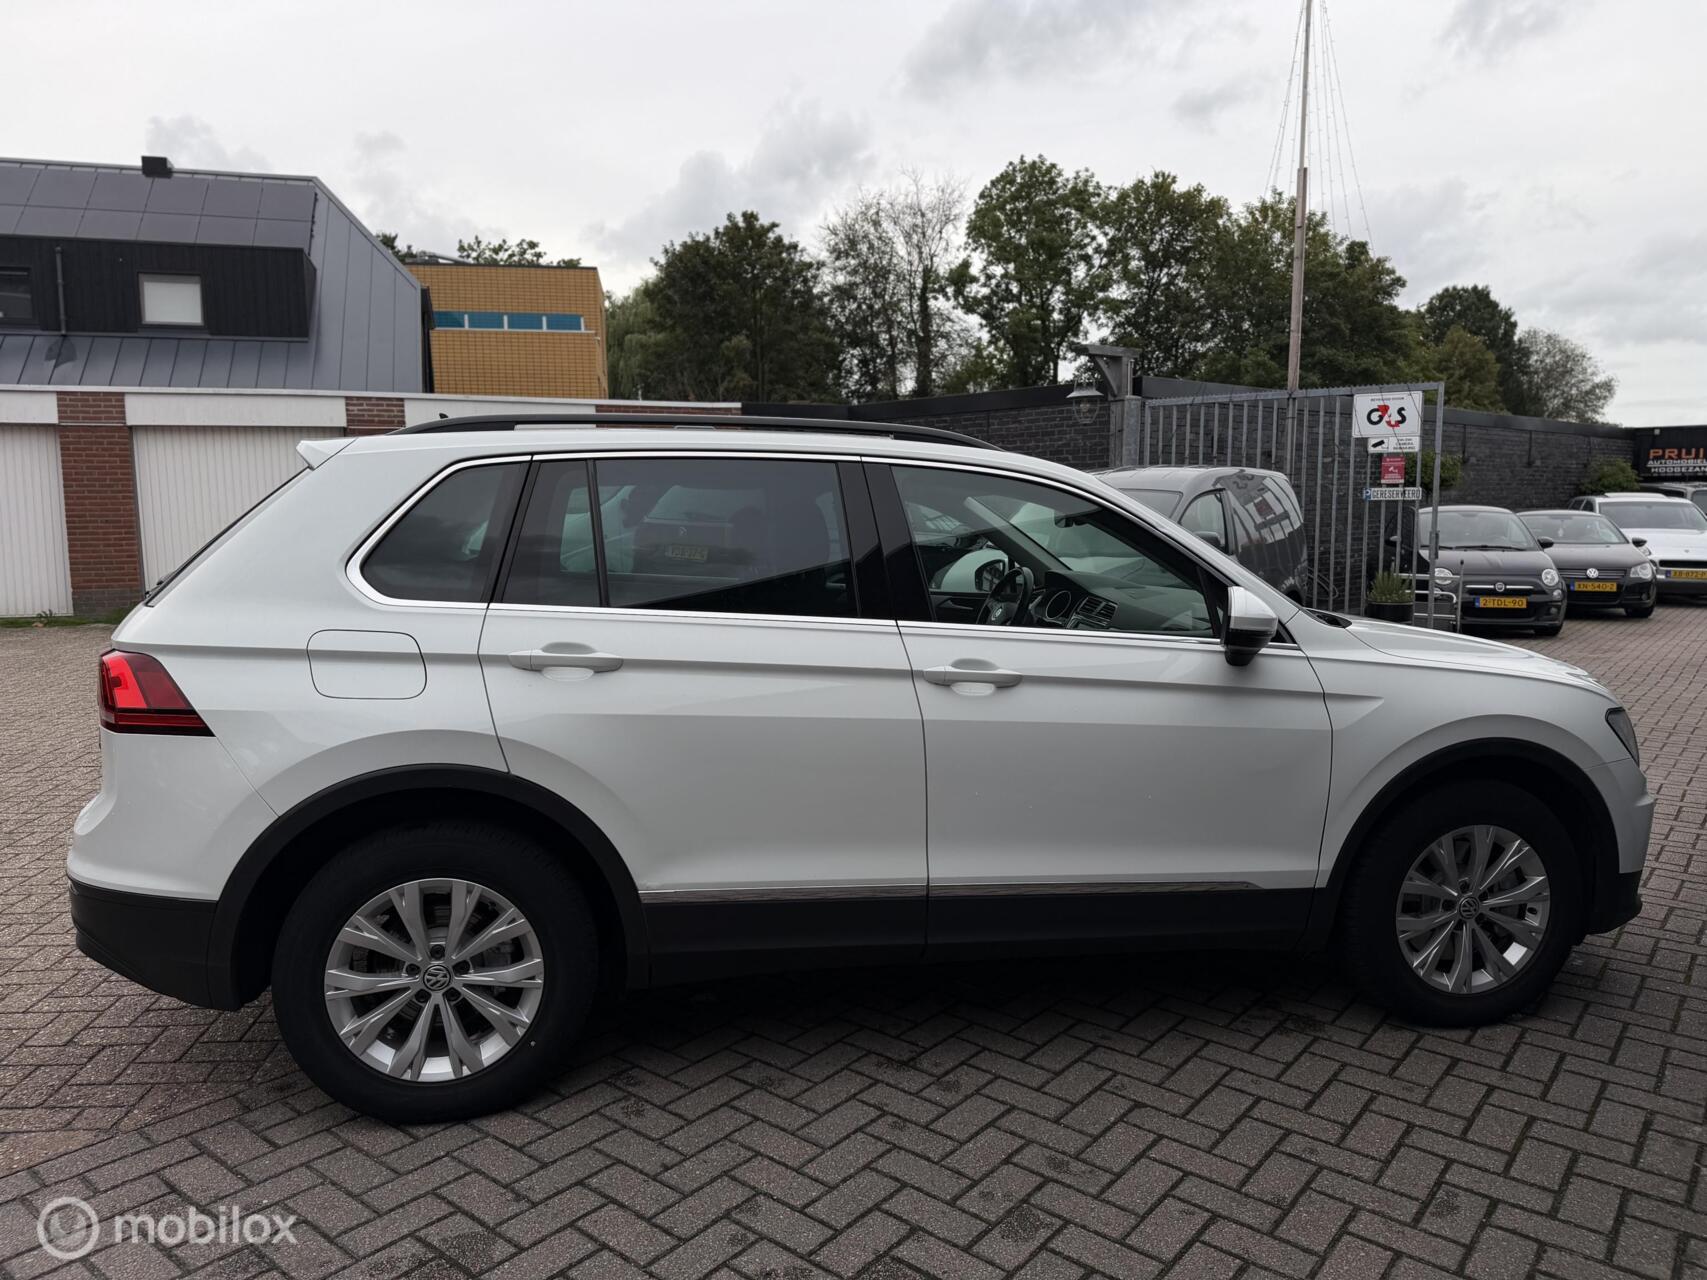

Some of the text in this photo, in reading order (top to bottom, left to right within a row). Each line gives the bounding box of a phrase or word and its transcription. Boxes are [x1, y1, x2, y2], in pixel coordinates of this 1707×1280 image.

[1649, 448, 1705, 460] PRUI
[1372, 489, 1421, 499] GERESERVEERD
[1481, 598, 1525, 607] 2-TDL-90
